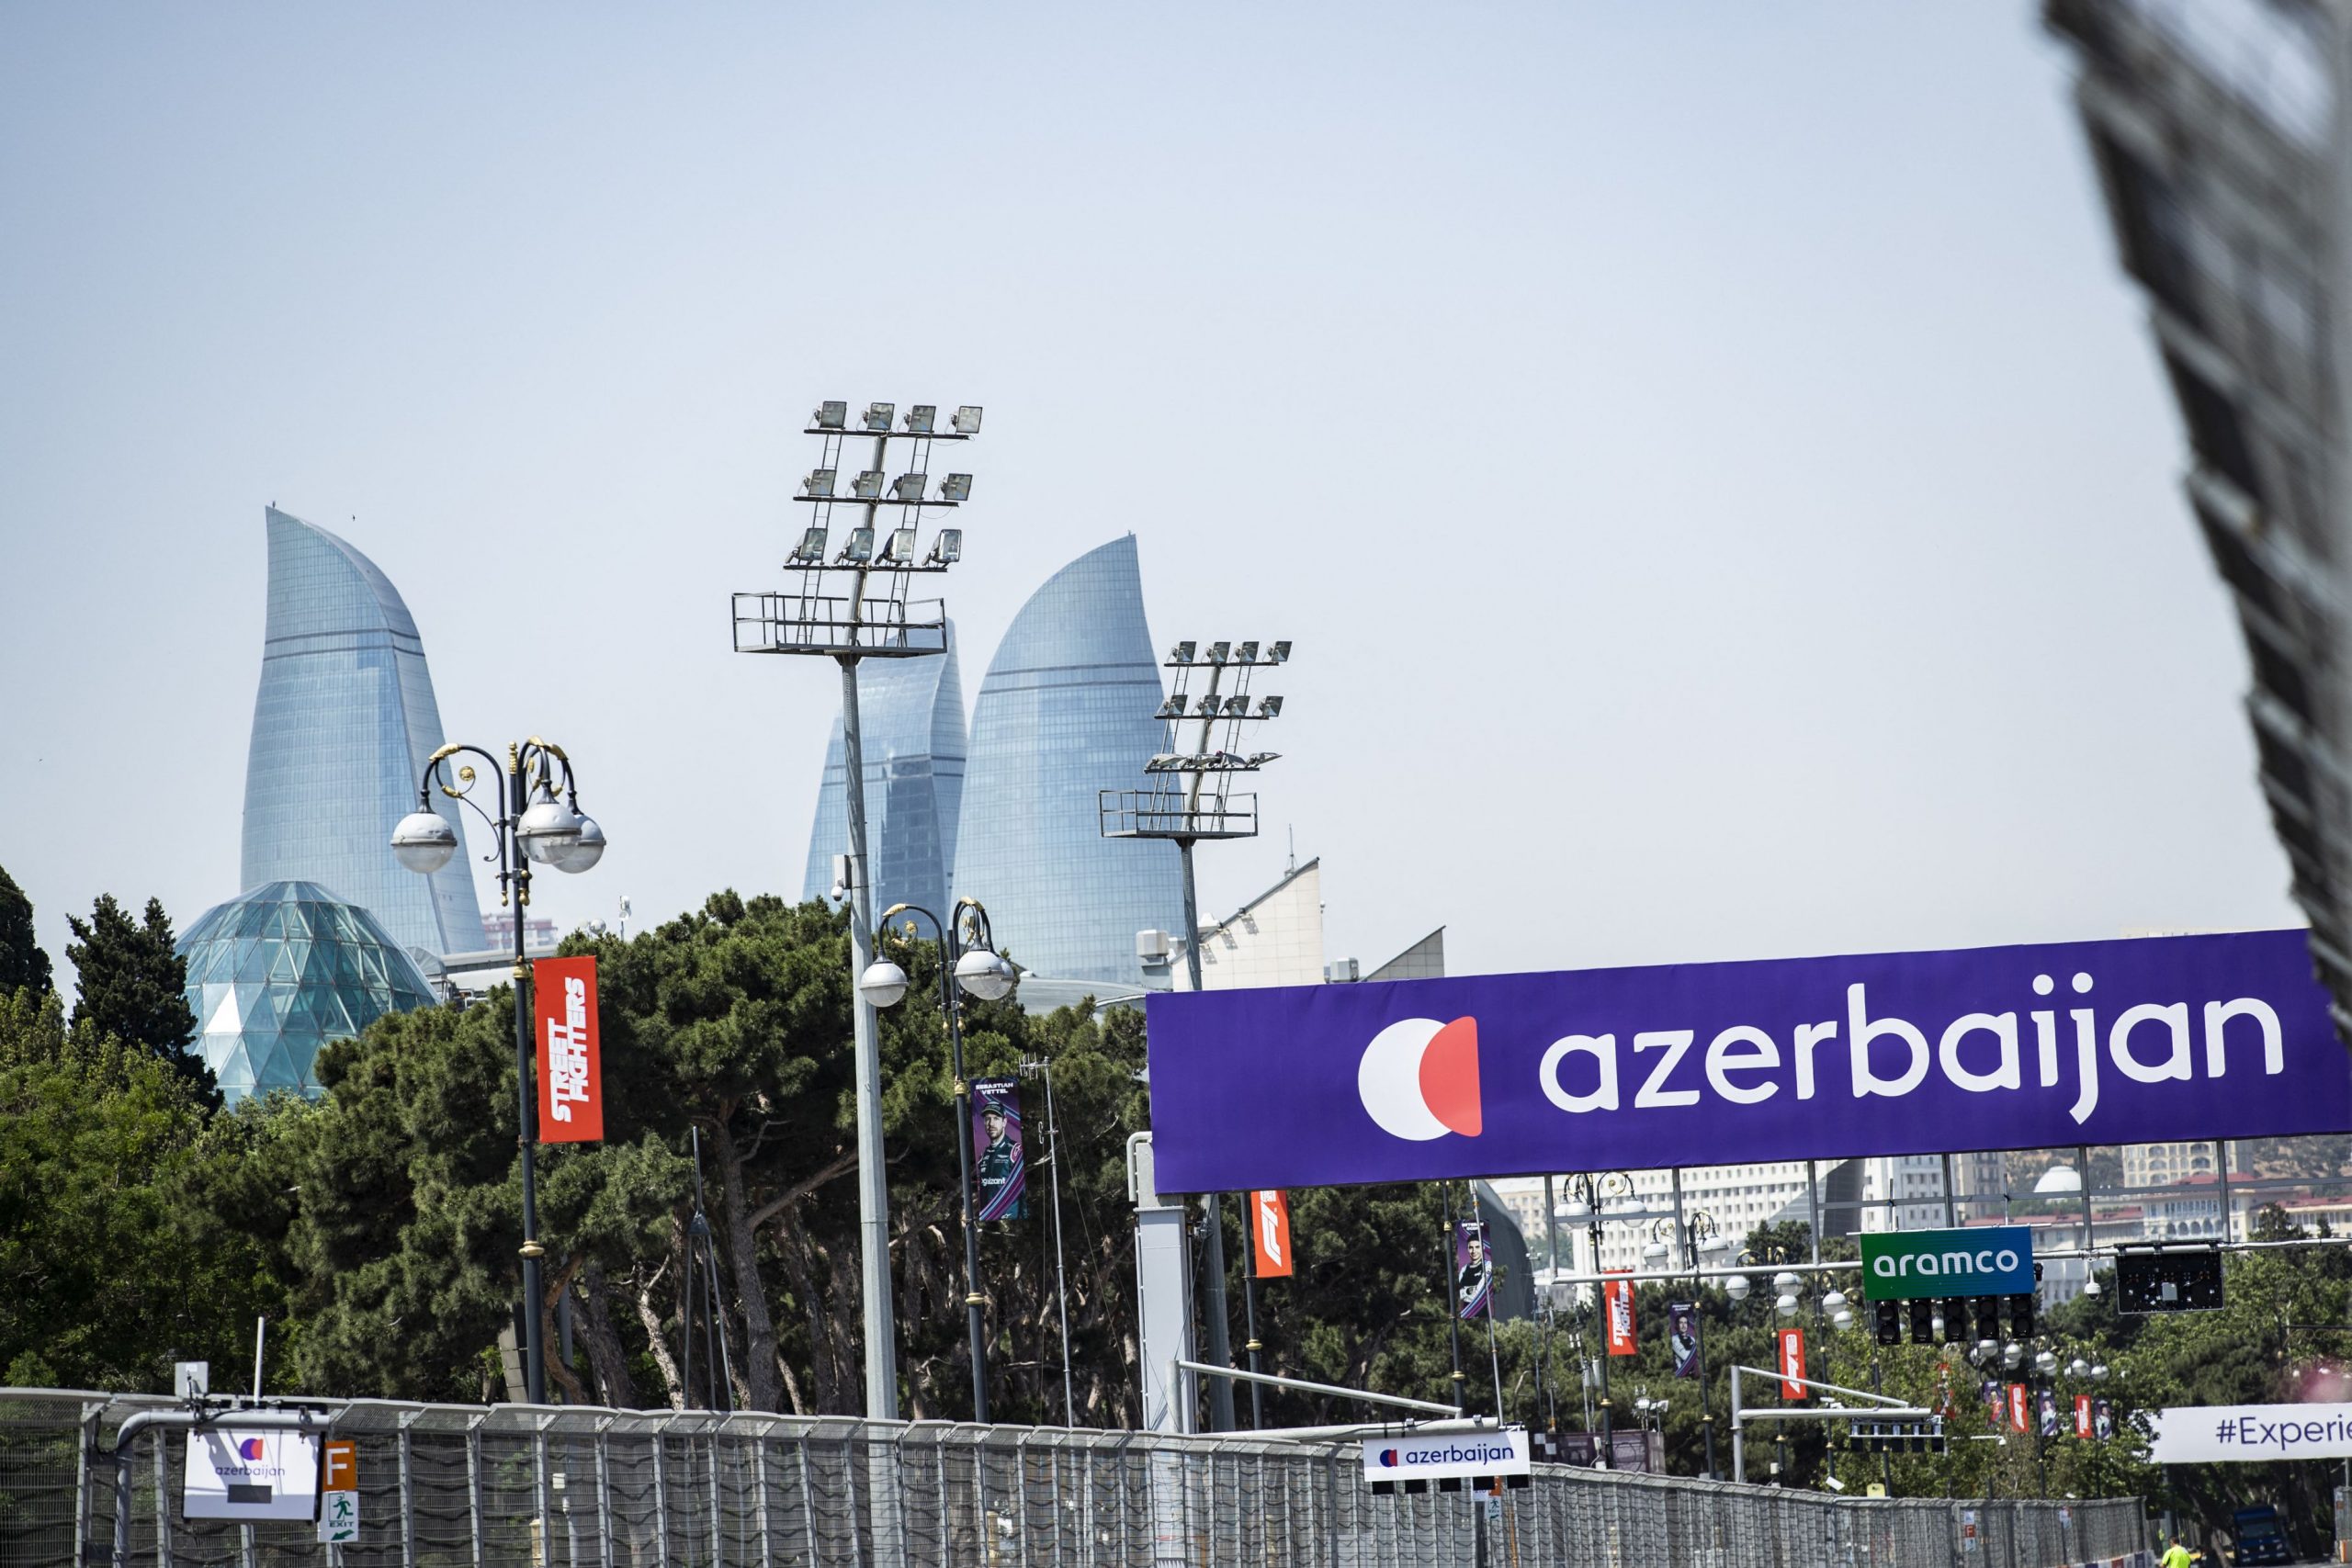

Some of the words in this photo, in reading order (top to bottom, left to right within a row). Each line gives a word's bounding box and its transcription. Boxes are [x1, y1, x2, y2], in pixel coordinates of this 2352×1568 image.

[565, 976, 589, 1102] FIGHTERS
[1540, 972, 2284, 1125] azerbaijan
[548, 1017, 571, 1122] STREET
[976, 1082, 1013, 1090] SEBASTIAN
[1873, 1249, 2018, 1277] aramco
[2215, 1413, 2352, 1451] #Experi
[215, 1465, 286, 1479] azerbaijan
[327, 1447, 350, 1485] F
[1406, 1443, 1514, 1465] azerbaijan
